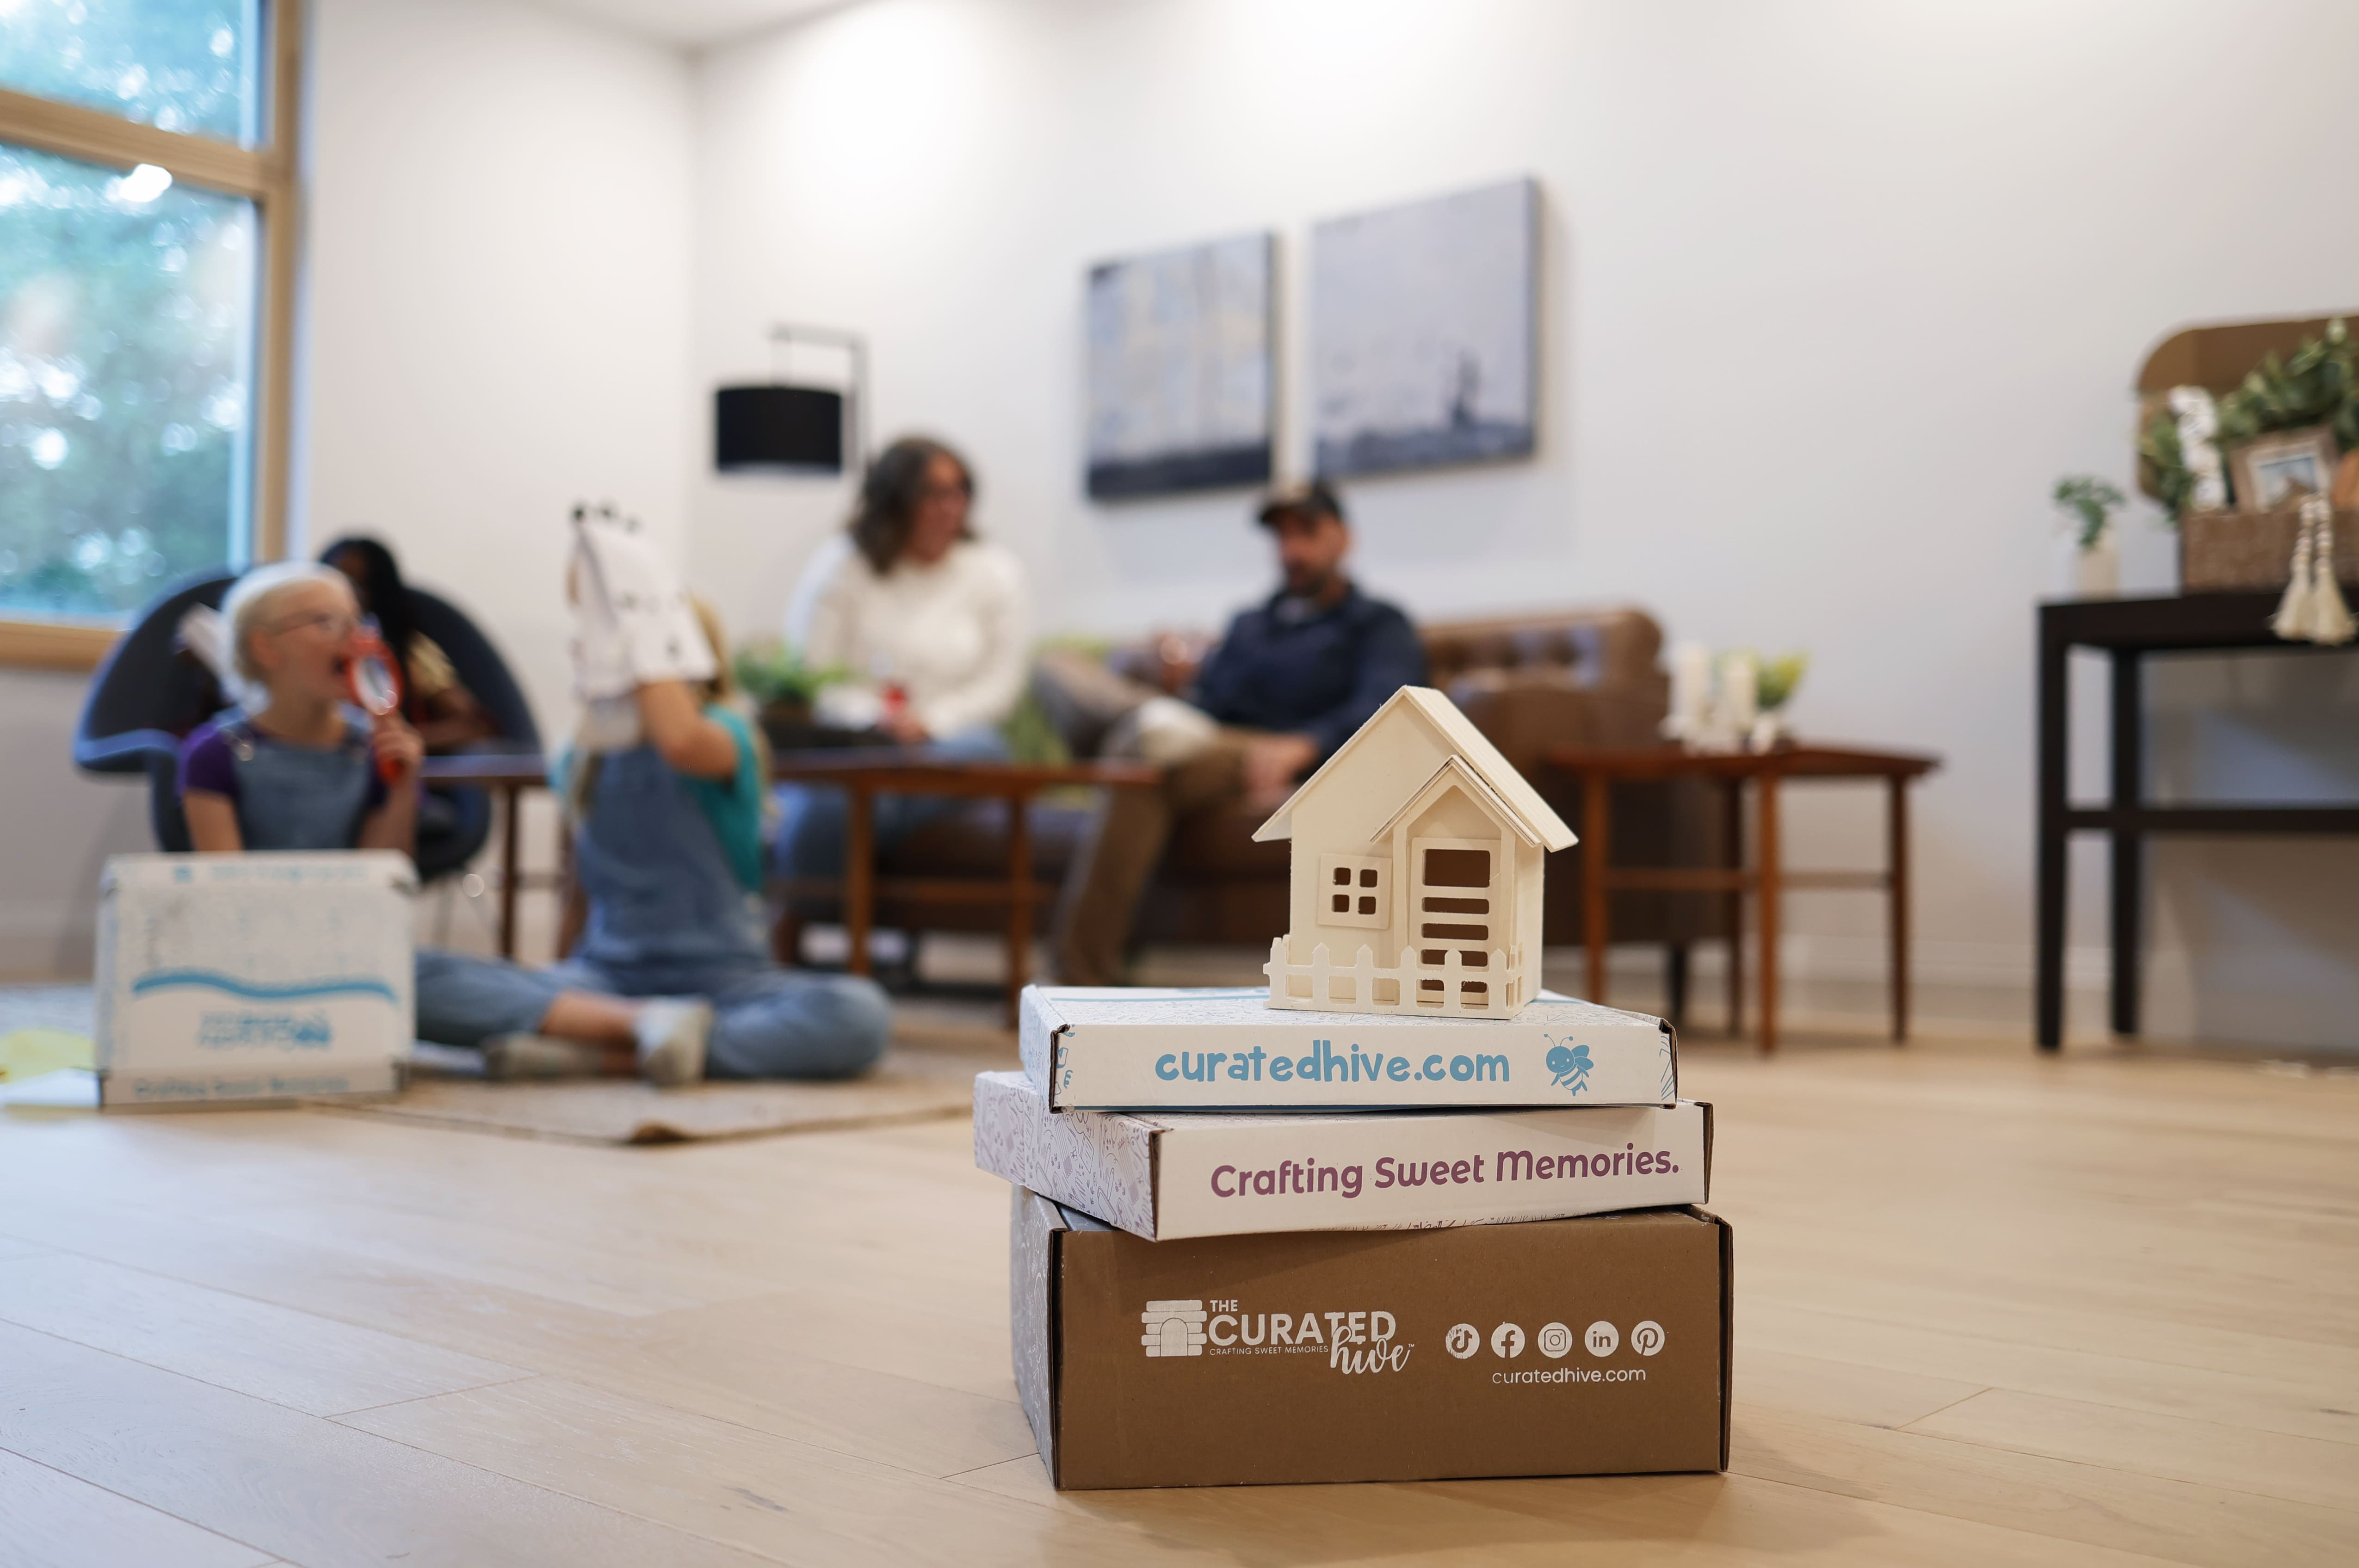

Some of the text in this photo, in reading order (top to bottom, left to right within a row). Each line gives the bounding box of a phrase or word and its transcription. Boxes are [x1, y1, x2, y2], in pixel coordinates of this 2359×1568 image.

[1155, 1039, 1510, 1082] curatedhive.com
[1211, 1142, 1680, 1198] Crafting Sweet Memories.
[1210, 1299, 1238, 1312] THE
[1208, 1310, 1397, 1346] CURATED
[1209, 1345, 1329, 1356] CRAFTING SWEET MEMORIES
[1492, 1367, 1646, 1384] curatedhive.com
